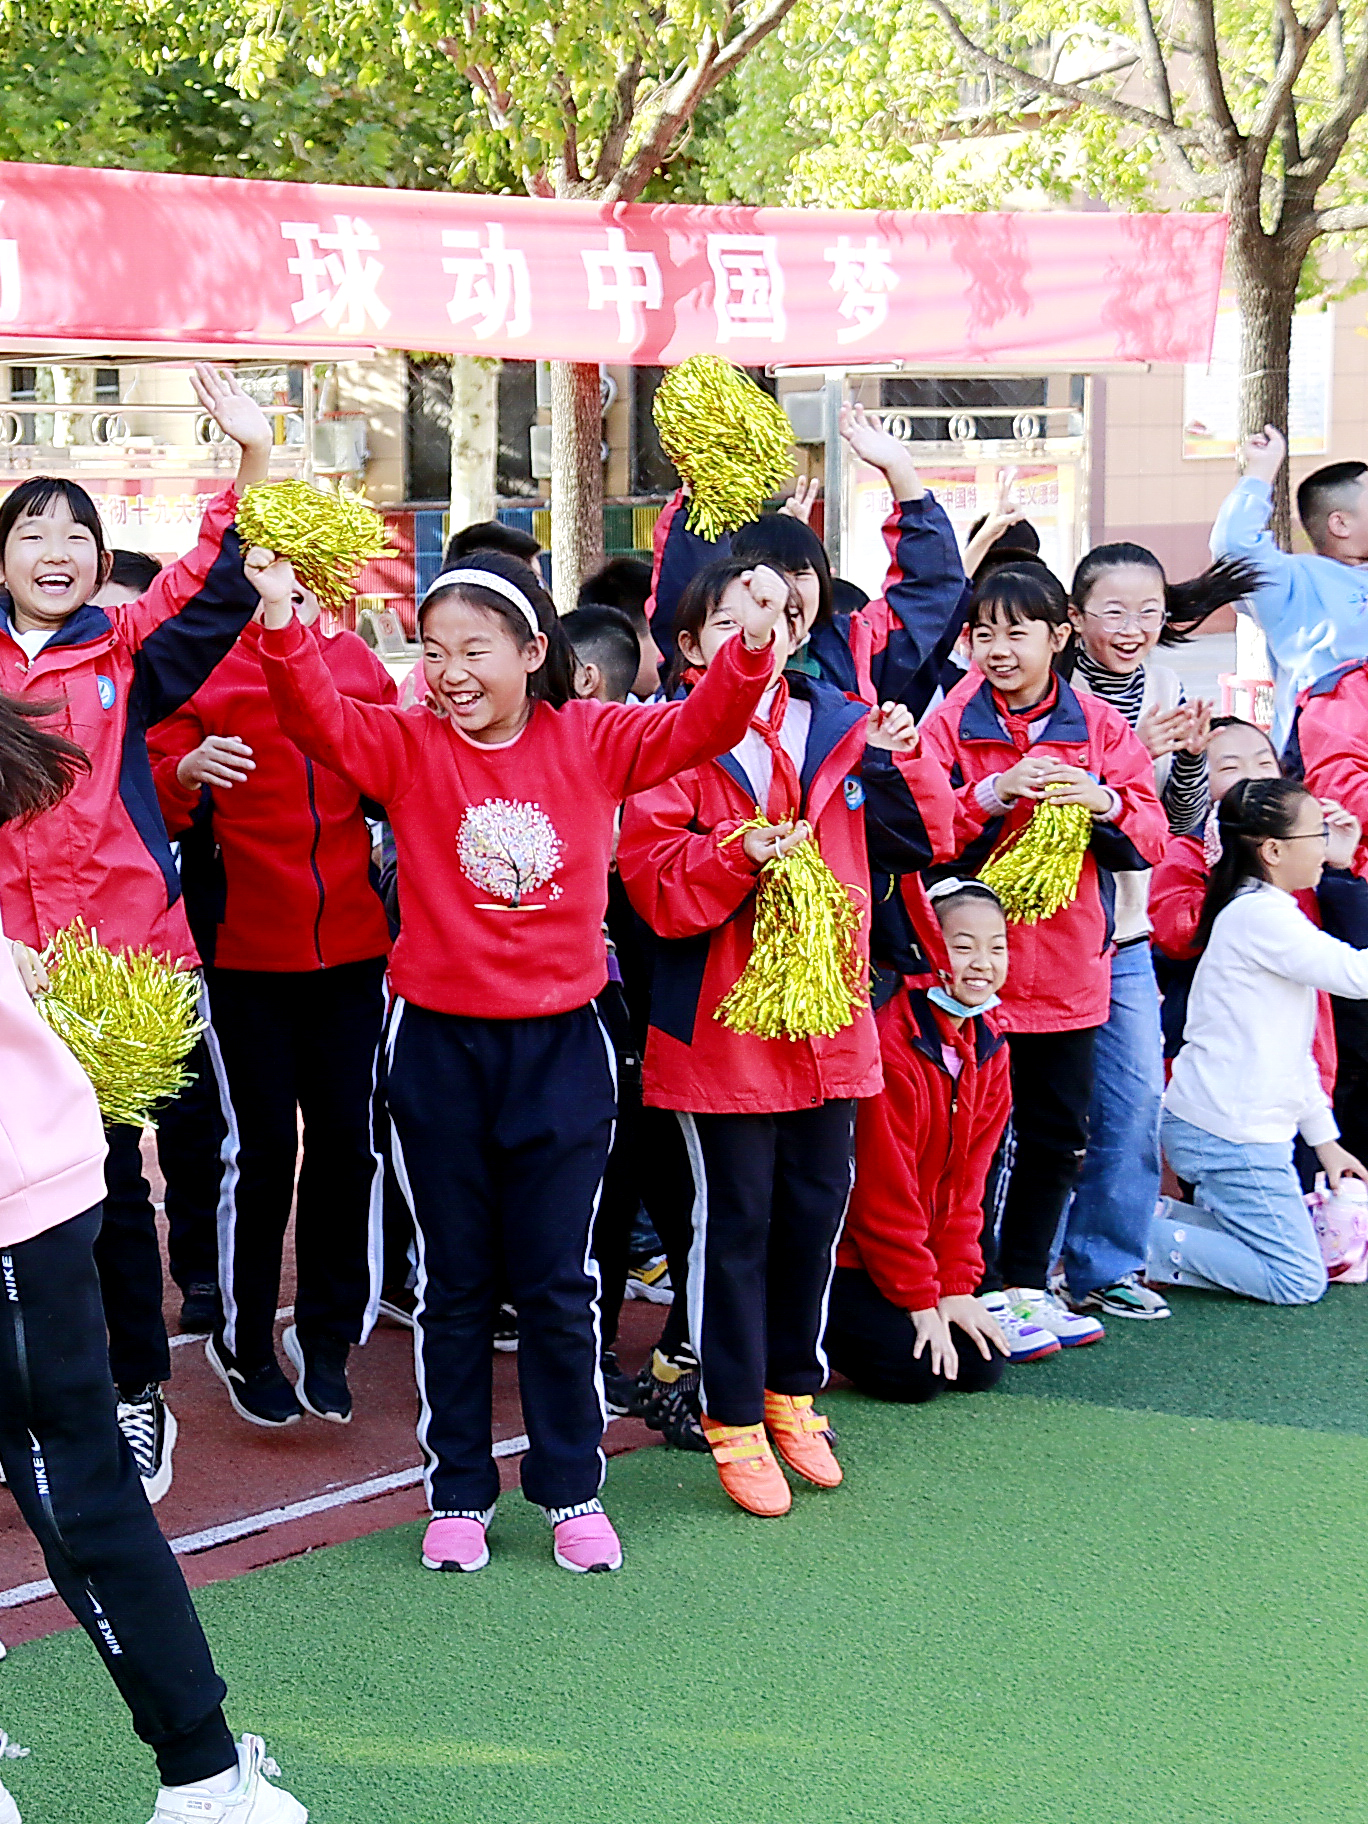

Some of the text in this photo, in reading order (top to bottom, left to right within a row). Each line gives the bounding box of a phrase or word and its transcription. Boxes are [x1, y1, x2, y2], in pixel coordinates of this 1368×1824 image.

[280, 215, 900, 345] 球动中国梦
[2, 1255, 19, 1301] NIKE
[32, 1457, 50, 1495] NIKE
[96, 1619, 123, 1655] NIKE
